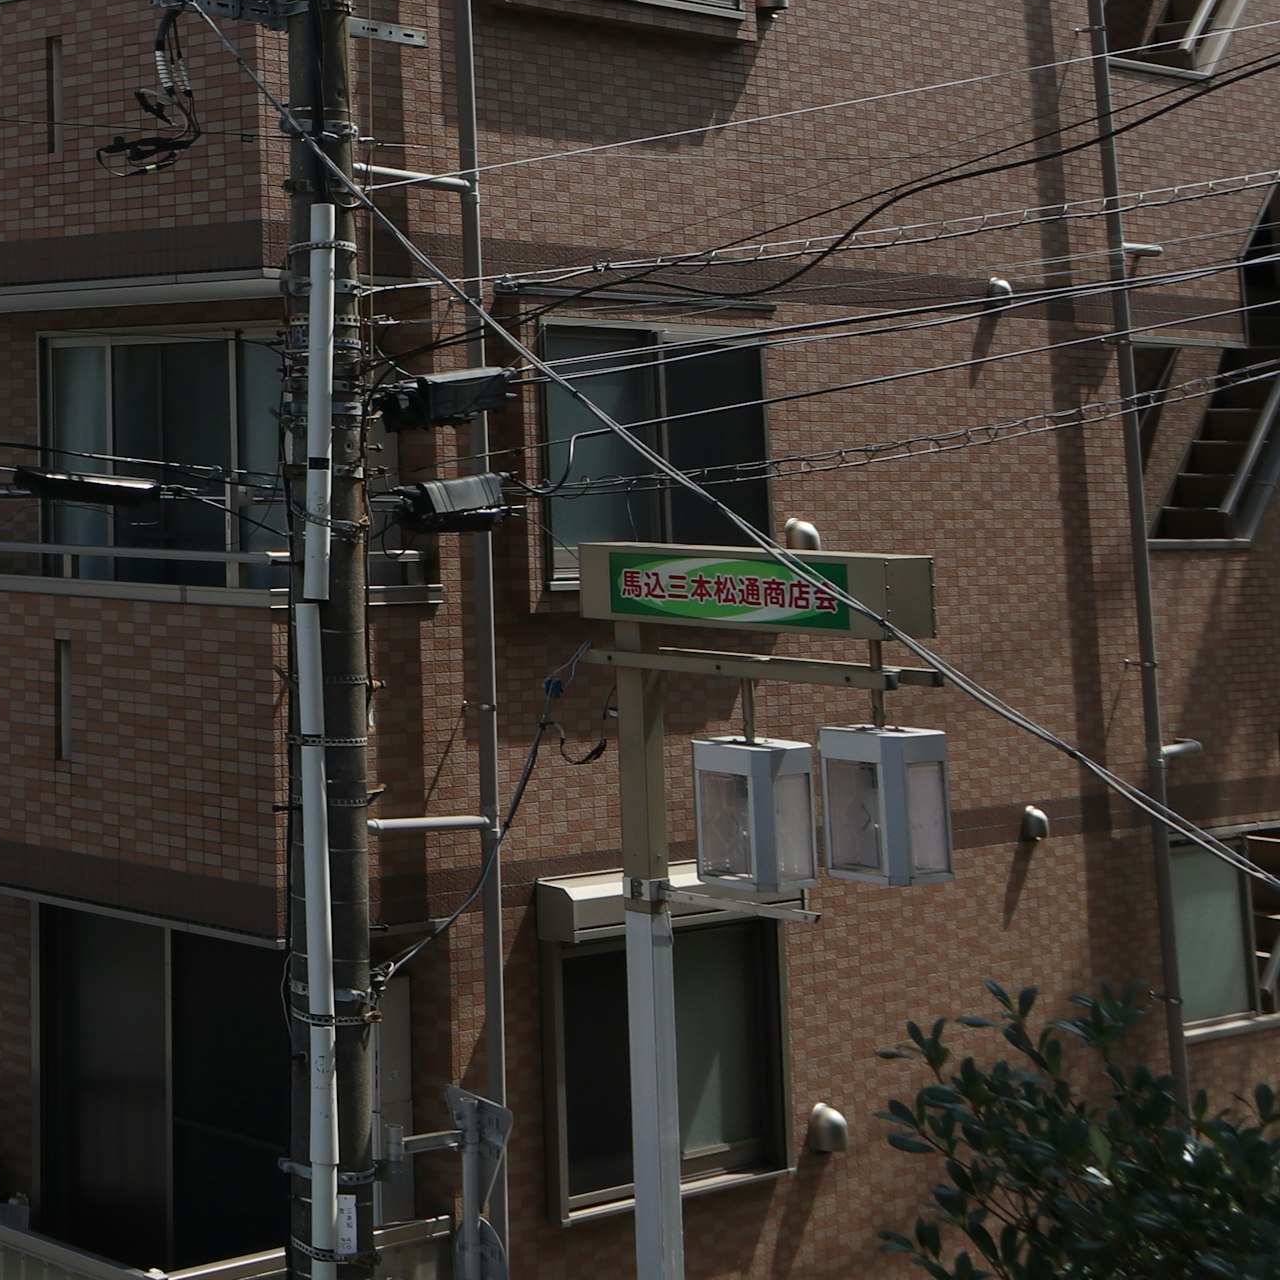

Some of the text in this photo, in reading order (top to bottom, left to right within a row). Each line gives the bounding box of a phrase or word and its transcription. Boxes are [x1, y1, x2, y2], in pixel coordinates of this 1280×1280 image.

[620, 569, 840, 613] 馬込三本松通商店会
